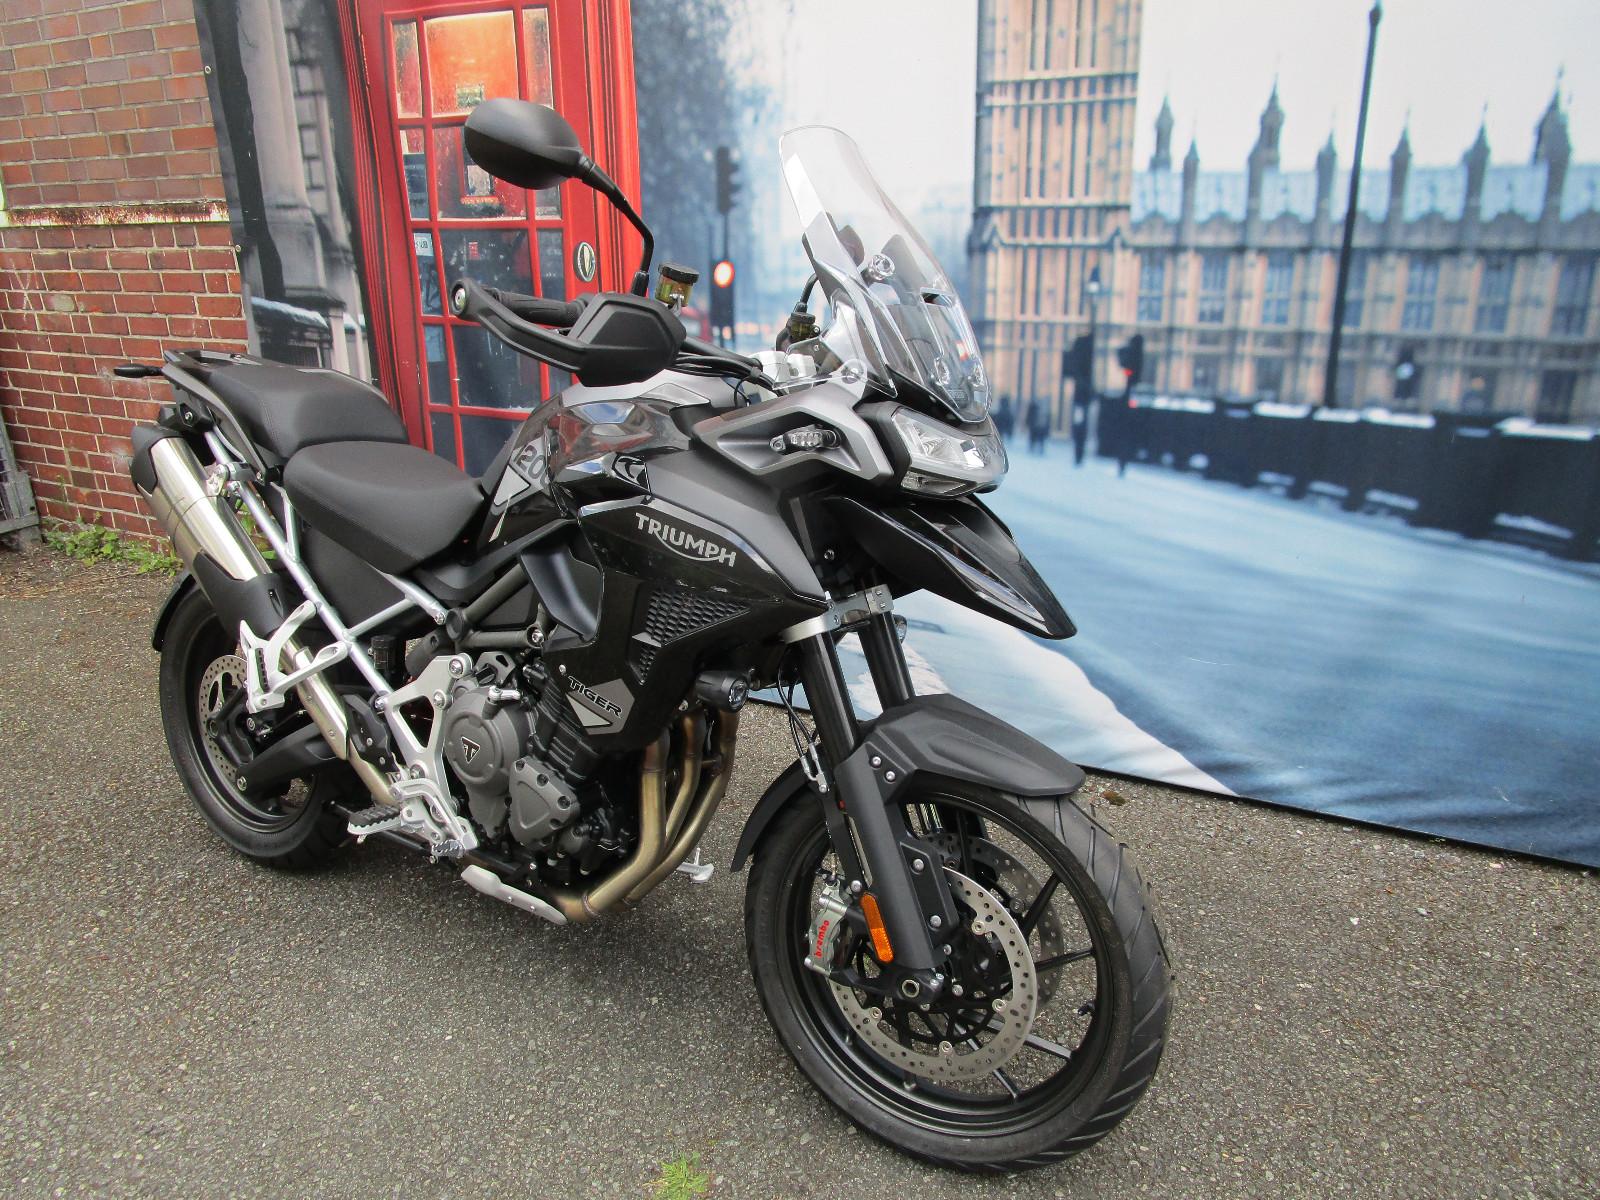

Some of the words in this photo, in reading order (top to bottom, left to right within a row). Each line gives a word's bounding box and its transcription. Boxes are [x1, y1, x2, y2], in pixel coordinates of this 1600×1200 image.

[635, 512, 737, 567] TRIUMPH
[567, 675, 622, 719] TIGER
[814, 919, 830, 958] brembo
